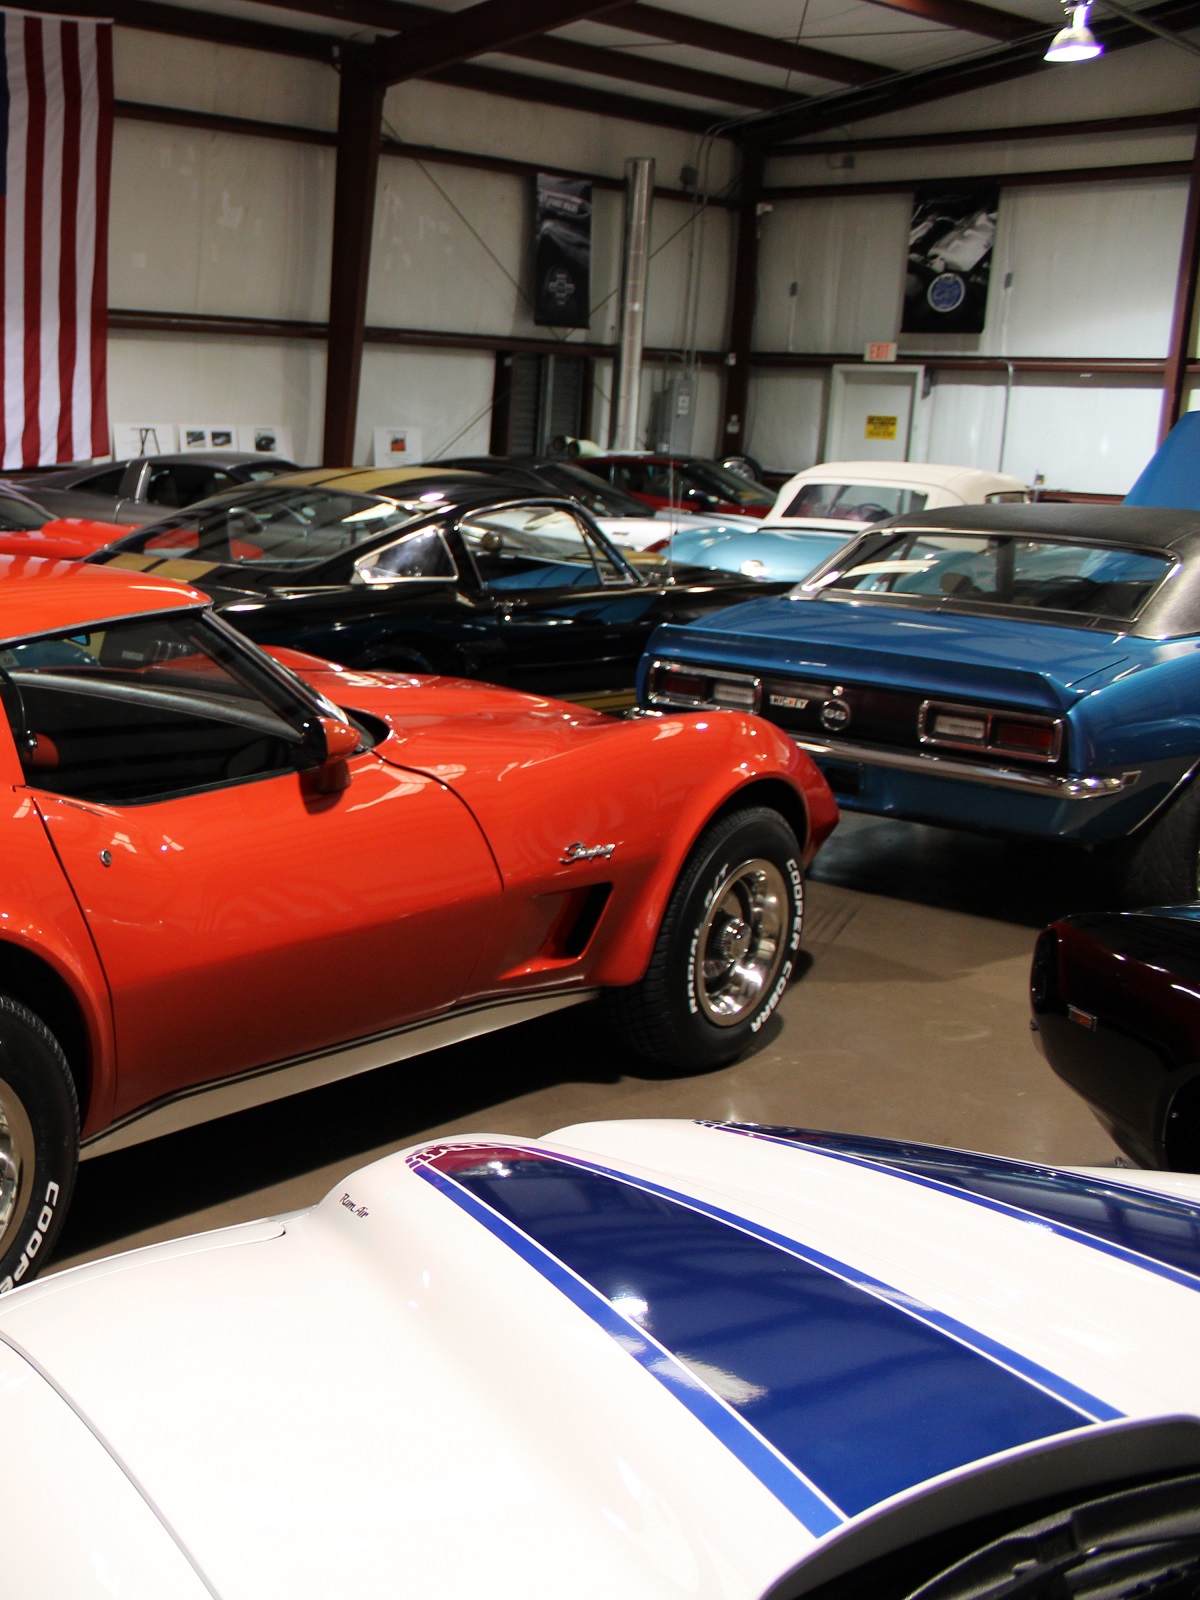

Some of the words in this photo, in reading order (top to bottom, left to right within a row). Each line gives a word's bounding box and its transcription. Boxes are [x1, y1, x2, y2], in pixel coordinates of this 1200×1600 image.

[869, 343, 893, 360] EXIT
[786, 858, 804, 950] COOPER
[751, 960, 793, 1032] COBRA
[339, 1192, 356, 1213] Ram
[355, 1206, 370, 1218] Air
